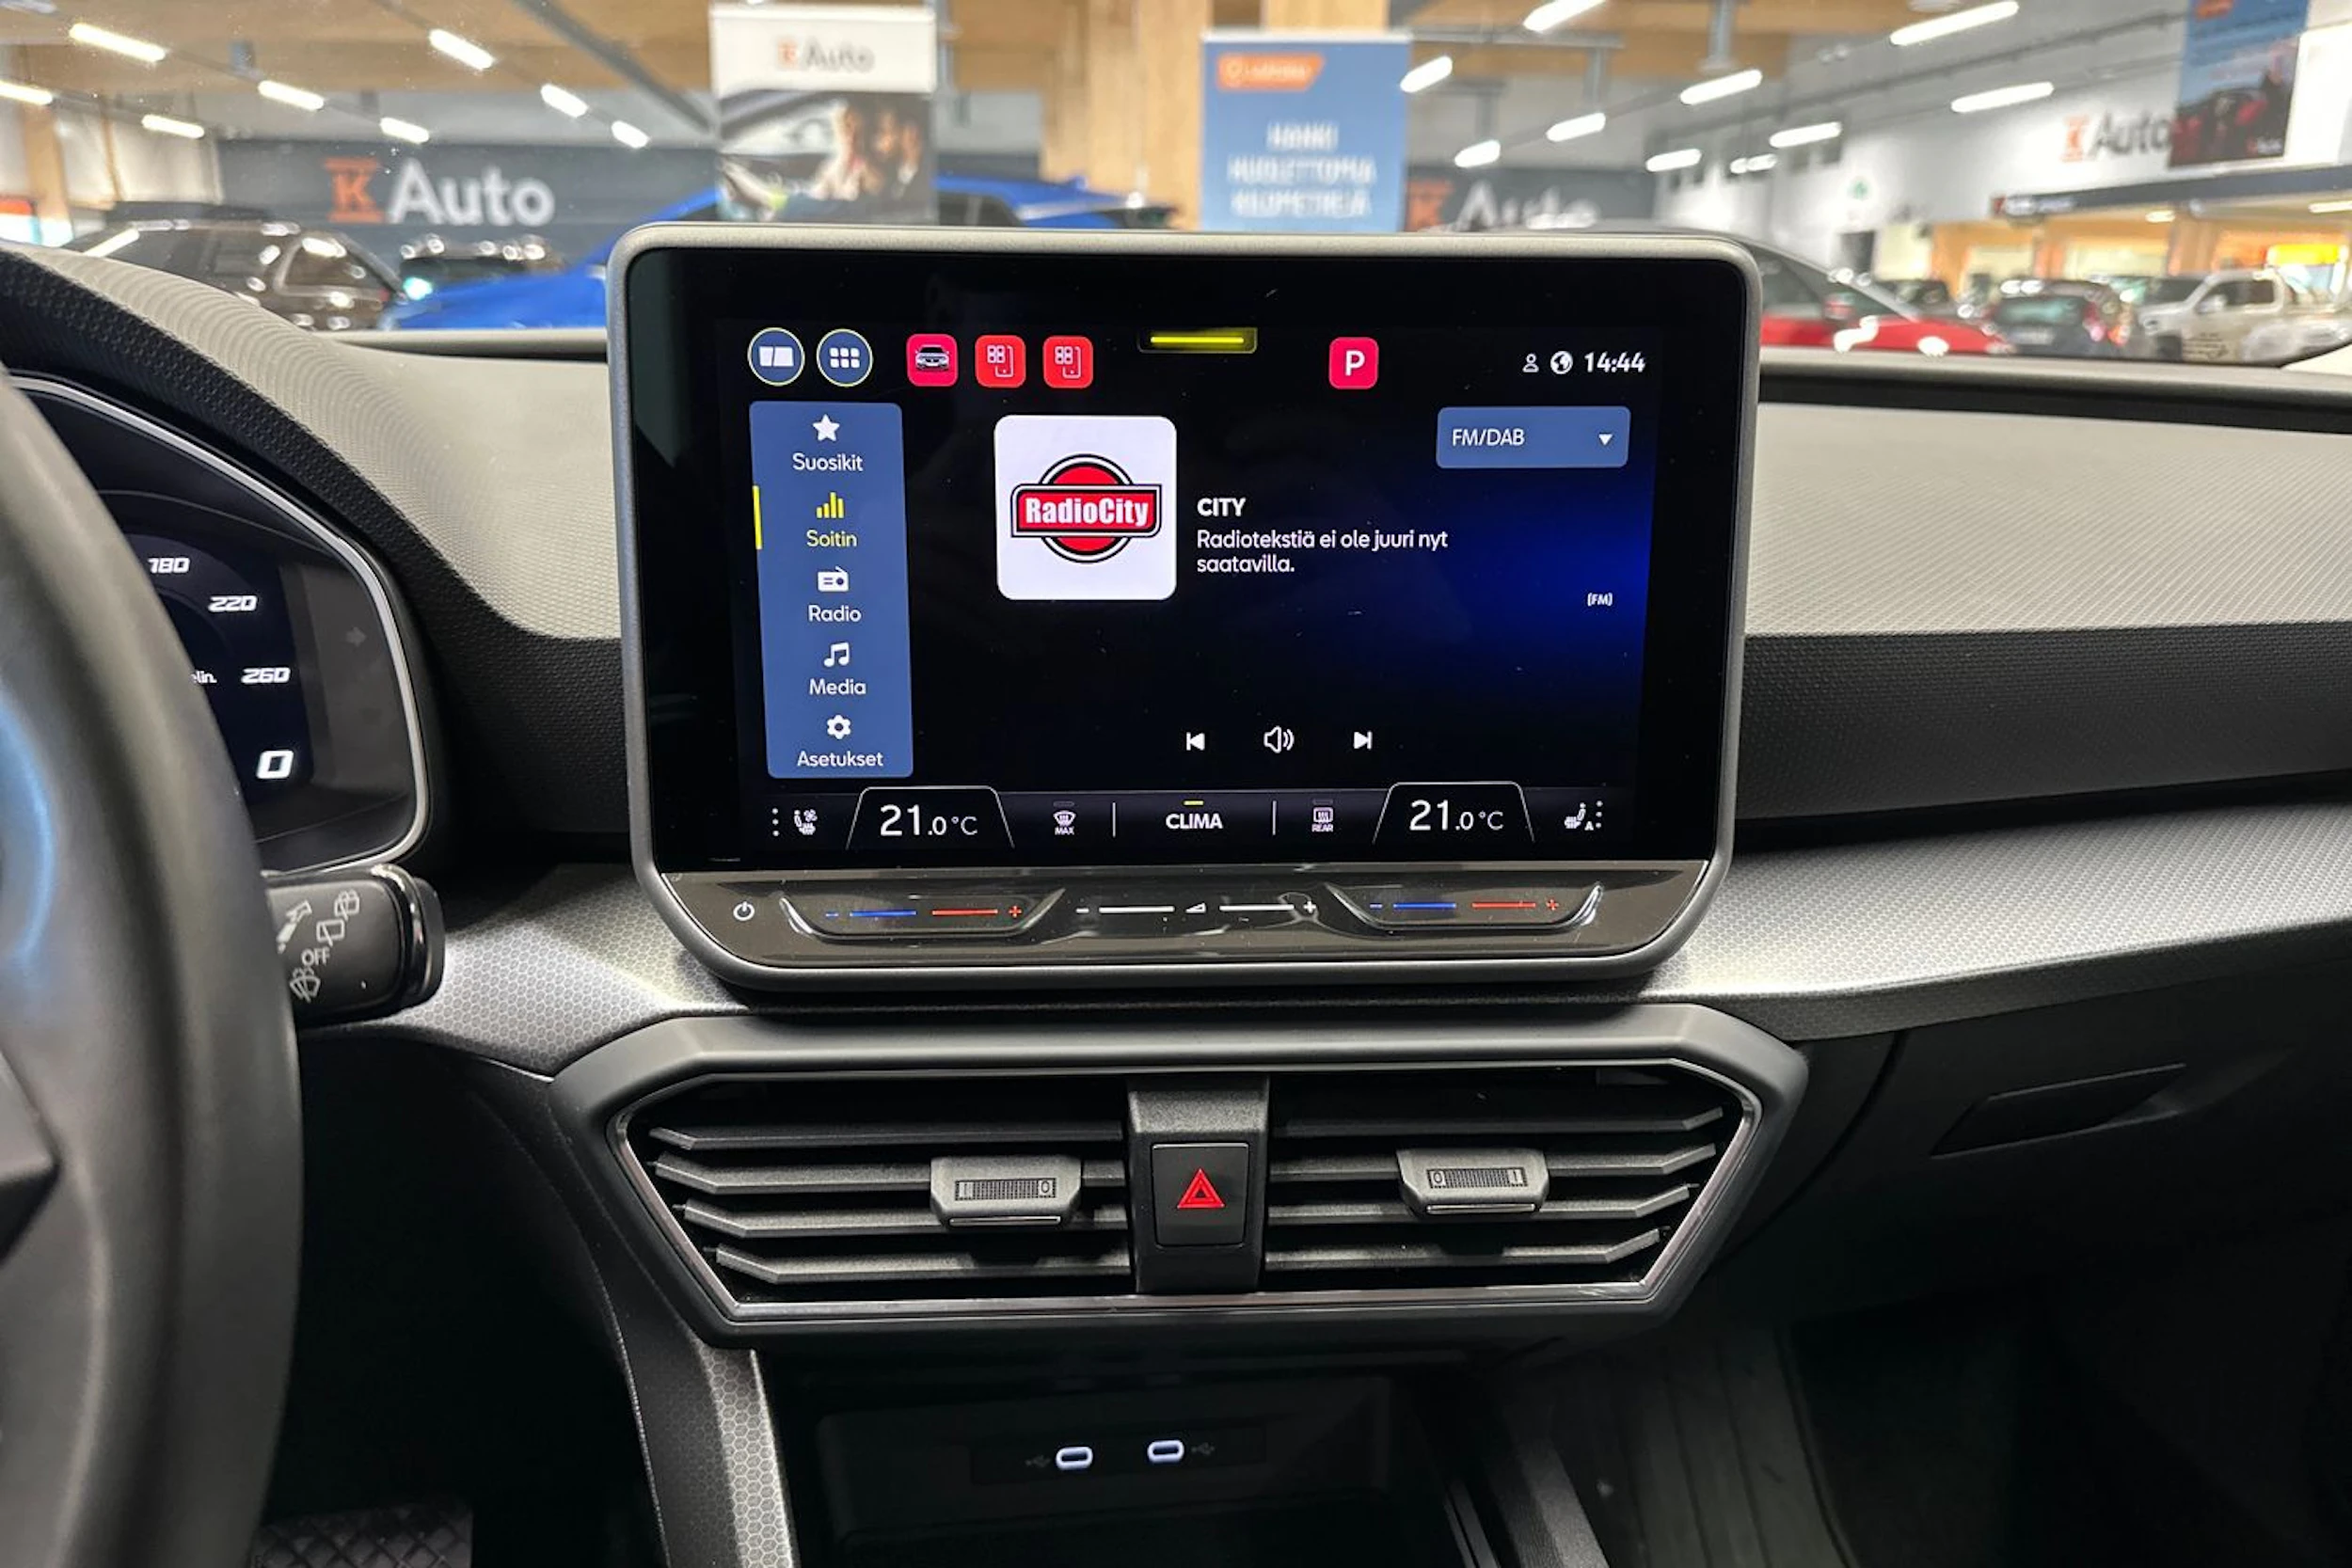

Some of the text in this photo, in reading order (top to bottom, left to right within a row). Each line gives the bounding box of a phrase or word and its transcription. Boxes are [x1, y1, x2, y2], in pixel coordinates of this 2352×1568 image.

[388, 158, 556, 226] Auto
[1345, 351, 1365, 375] P
[1584, 352, 1645, 372] 14:44
[1452, 429, 1525, 447] FM/DAB
[792, 452, 864, 471] Suosikit
[1025, 497, 1149, 527] RadioCity
[1197, 497, 1247, 517] CITY
[806, 530, 858, 547] Soitin
[1197, 529, 1449, 553] Radiotekstiä ei ole juuri nyt
[148, 557, 191, 574] 180
[1197, 554, 1295, 574] saatavilla.
[208, 594, 259, 612] 220
[808, 605, 862, 623] Radio
[241, 667, 292, 685] 260
[809, 678, 866, 695] Media
[256, 750, 294, 780] 0
[797, 751, 883, 768] Asetukset
[1054, 826, 1075, 835] MAX
[1165, 813, 1223, 830] CLIMA
[301, 946, 329, 966] OFF
